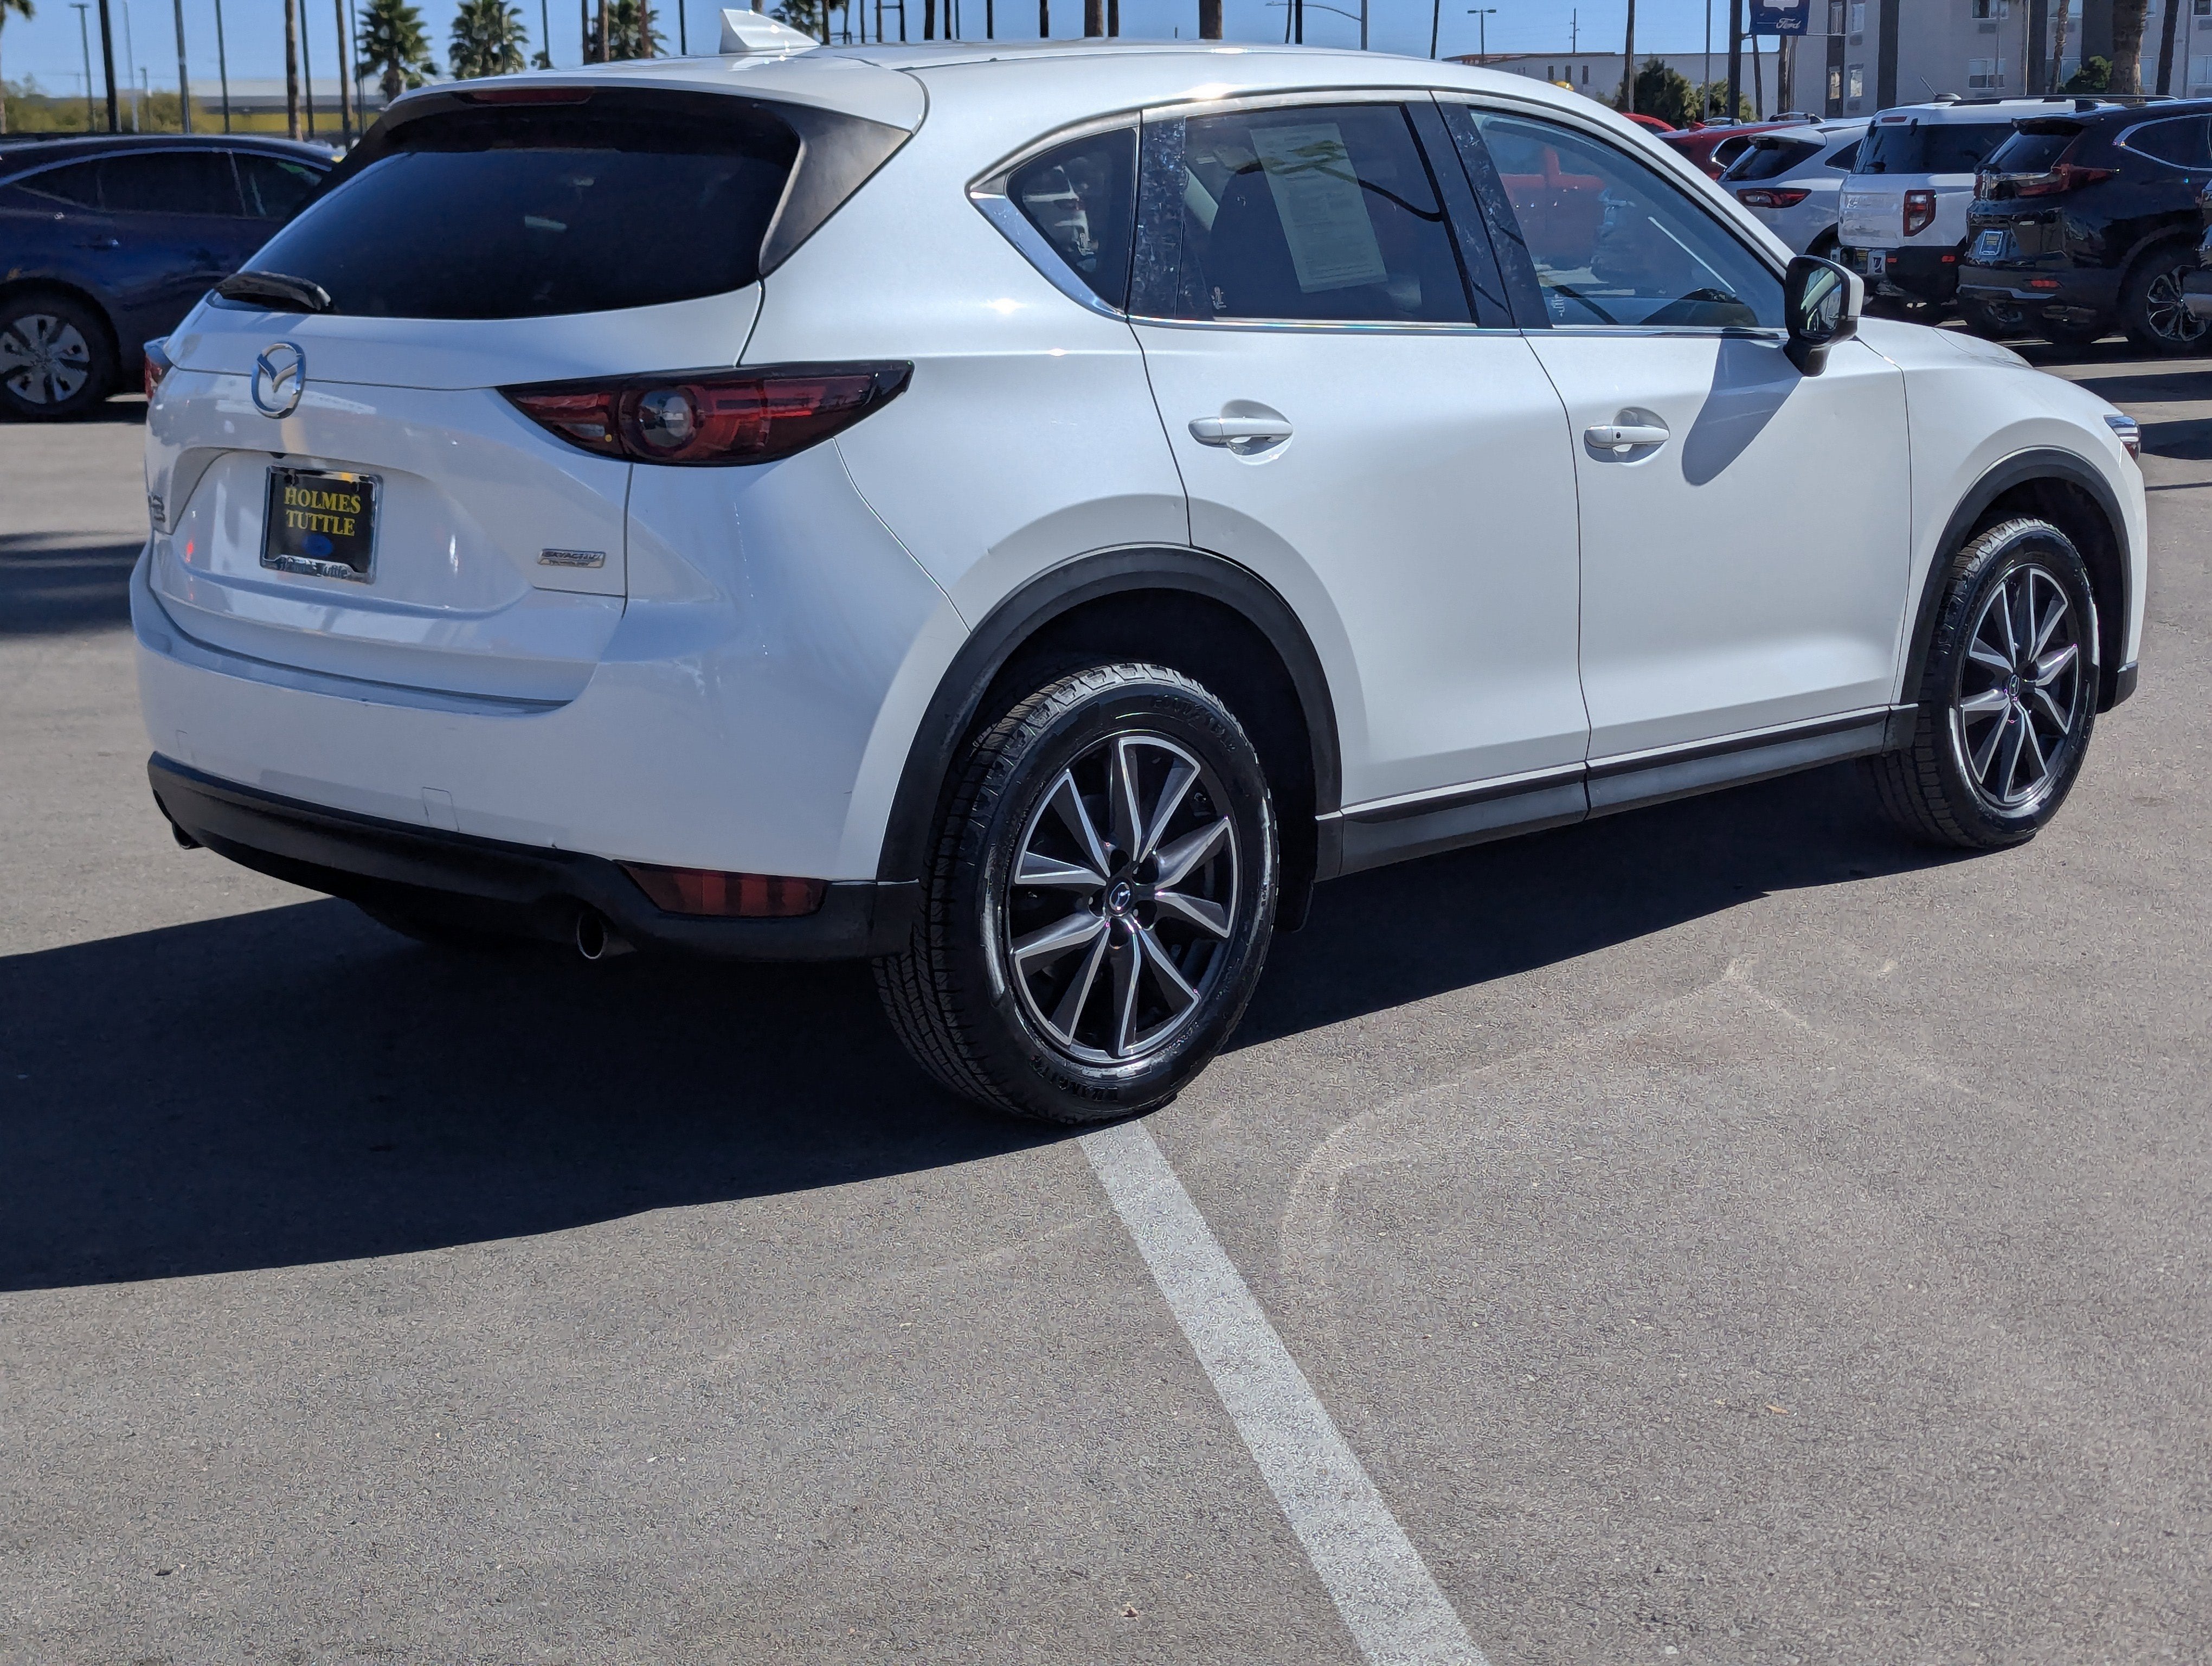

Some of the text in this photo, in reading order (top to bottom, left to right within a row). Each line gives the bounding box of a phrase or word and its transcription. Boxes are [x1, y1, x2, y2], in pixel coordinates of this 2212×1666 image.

[1776, 18, 1802, 29] Ford
[284, 486, 362, 514] HOLMES
[286, 509, 356, 536] TUTTLE
